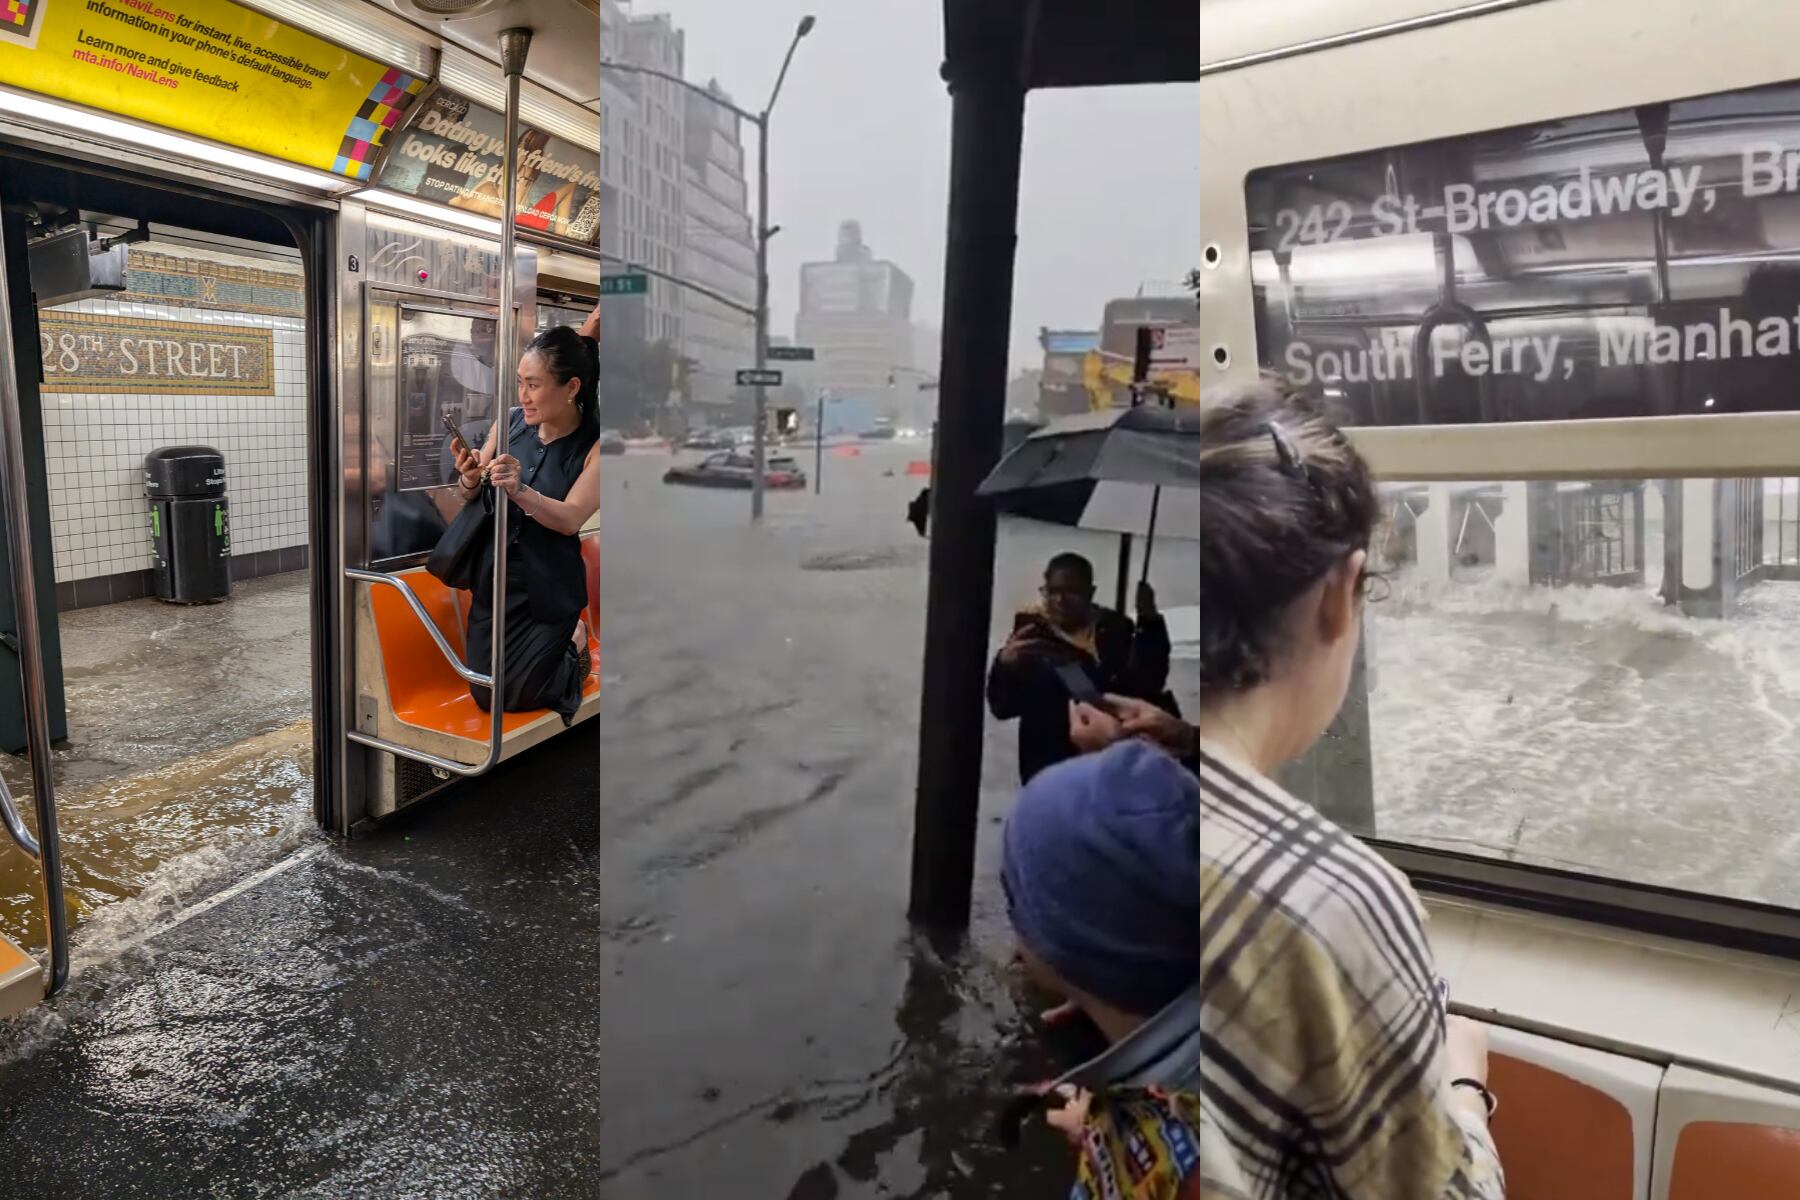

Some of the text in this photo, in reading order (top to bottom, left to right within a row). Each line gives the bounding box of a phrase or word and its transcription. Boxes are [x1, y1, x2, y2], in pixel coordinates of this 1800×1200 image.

[72, 48, 179, 89] mta.info/NaviLens
[77, 29, 240, 92] Learn more and give feedback
[86, 0, 312, 89] information in your phone's default language.
[176, 14, 194, 29] for
[192, 20, 231, 46] instant,
[232, 36, 252, 54] live,
[253, 45, 304, 71] accessible
[303, 63, 330, 80] travel
[401, 134, 457, 168] looks
[454, 151, 488, 178] like
[419, 110, 489, 151] Dating
[425, 177, 444, 188] STOP
[443, 183, 472, 198] DATING
[1276, 201, 1354, 252] 242
[1371, 162, 1716, 238] St-Broadway,
[349, 256, 358, 271] 3
[1284, 328, 1412, 387] South
[1433, 327, 1574, 382] Ferry,
